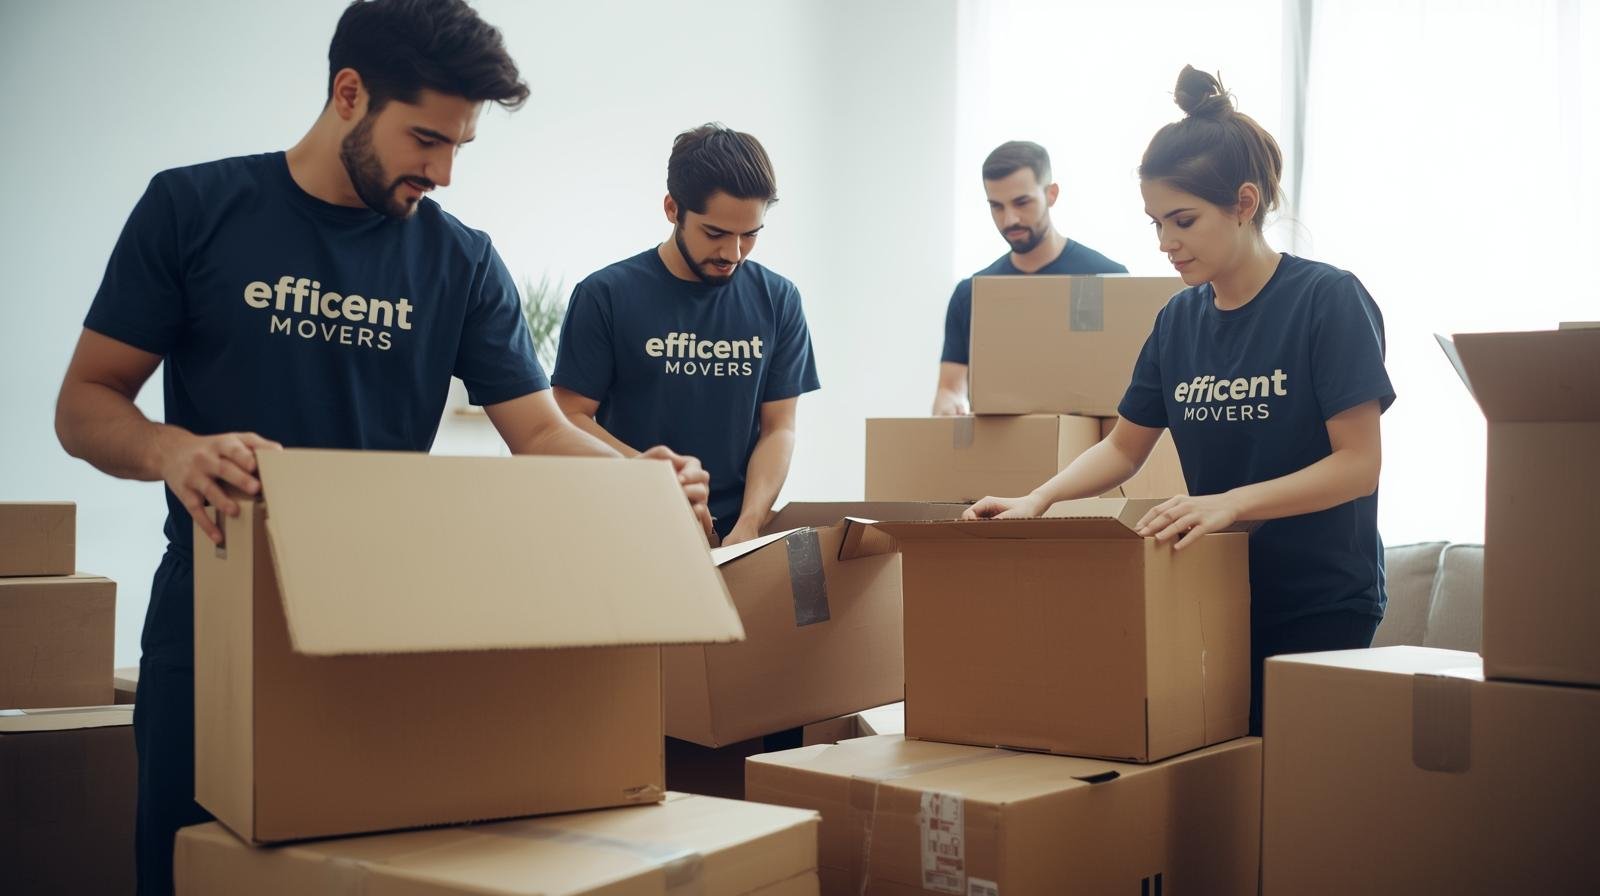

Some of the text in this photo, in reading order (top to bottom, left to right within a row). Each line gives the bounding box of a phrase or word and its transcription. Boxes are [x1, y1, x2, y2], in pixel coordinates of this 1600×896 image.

[243, 275, 413, 330] efficent
[270, 314, 392, 350] MOVERS
[645, 332, 764, 360] efficent
[665, 360, 753, 377] MOVERS
[1174, 368, 1288, 404] efficent
[1183, 403, 1270, 422] MOVERS
